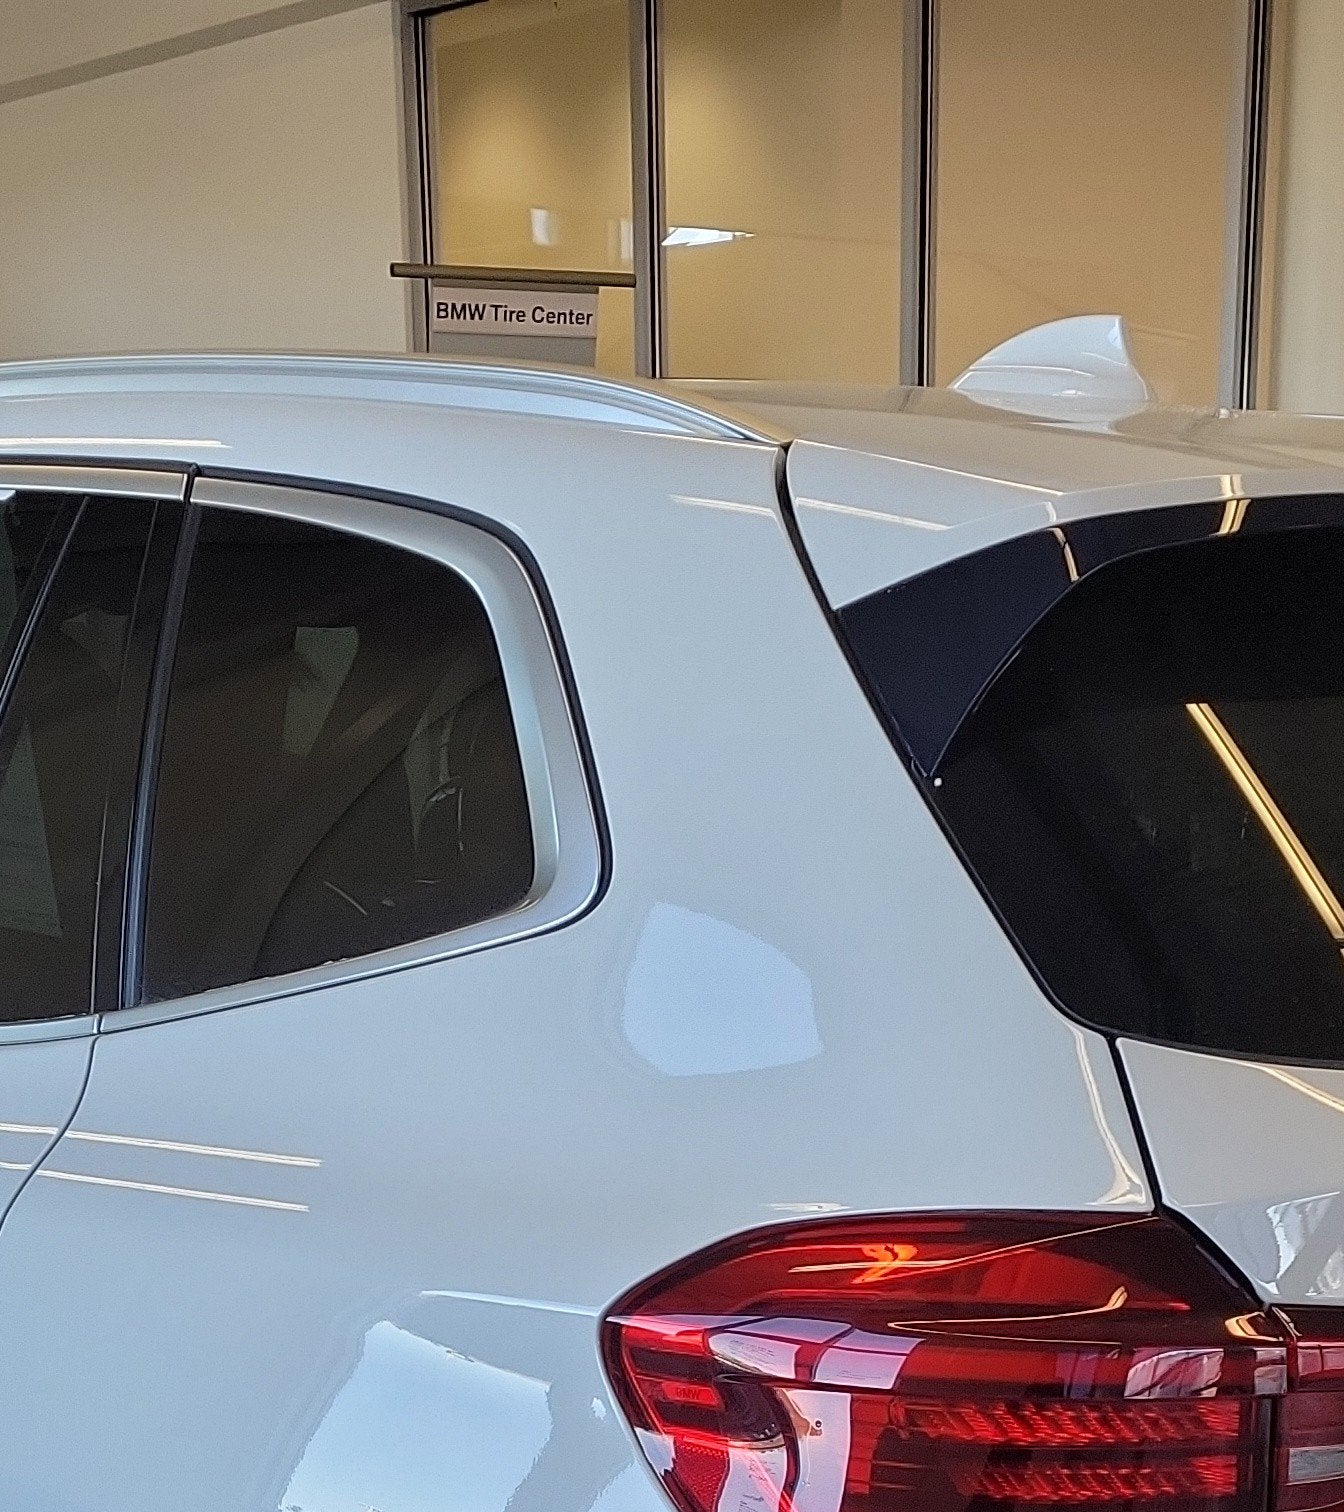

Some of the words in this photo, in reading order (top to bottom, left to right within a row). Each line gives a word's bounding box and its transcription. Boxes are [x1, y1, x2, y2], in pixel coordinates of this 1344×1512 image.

[436, 301, 486, 322] BMW
[489, 304, 527, 324] Tire
[531, 305, 594, 326] Center
